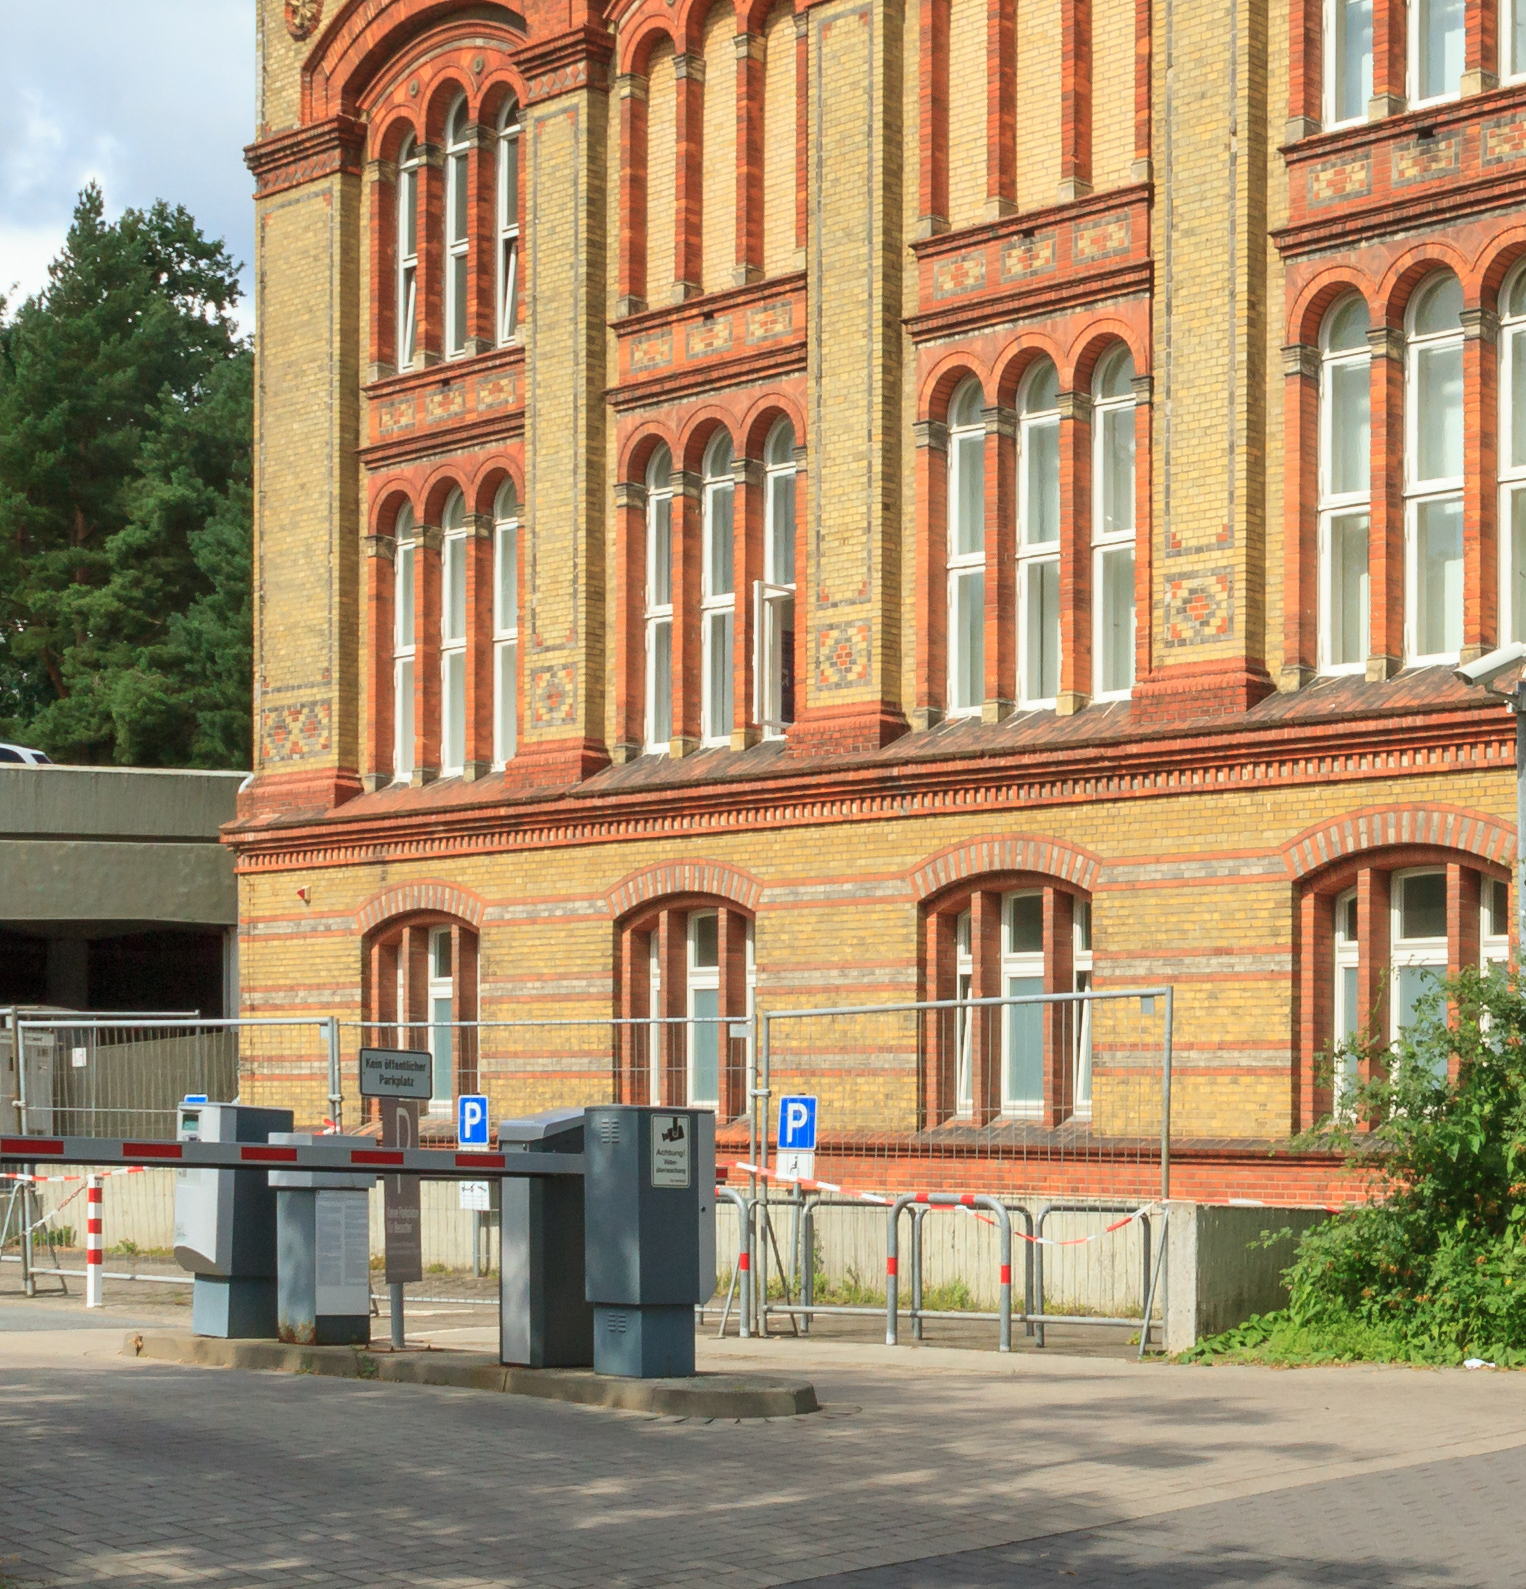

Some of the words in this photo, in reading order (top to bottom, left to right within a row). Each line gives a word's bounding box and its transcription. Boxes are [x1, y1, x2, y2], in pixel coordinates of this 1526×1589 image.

[366, 1058, 382, 1069] Kein
[384, 1058, 426, 1072] öffentlicher
[379, 1074, 414, 1088] Parkplatz
[465, 1102, 481, 1138] P
[787, 1103, 808, 1143] P
[656, 1149, 686, 1158] Achtung!
